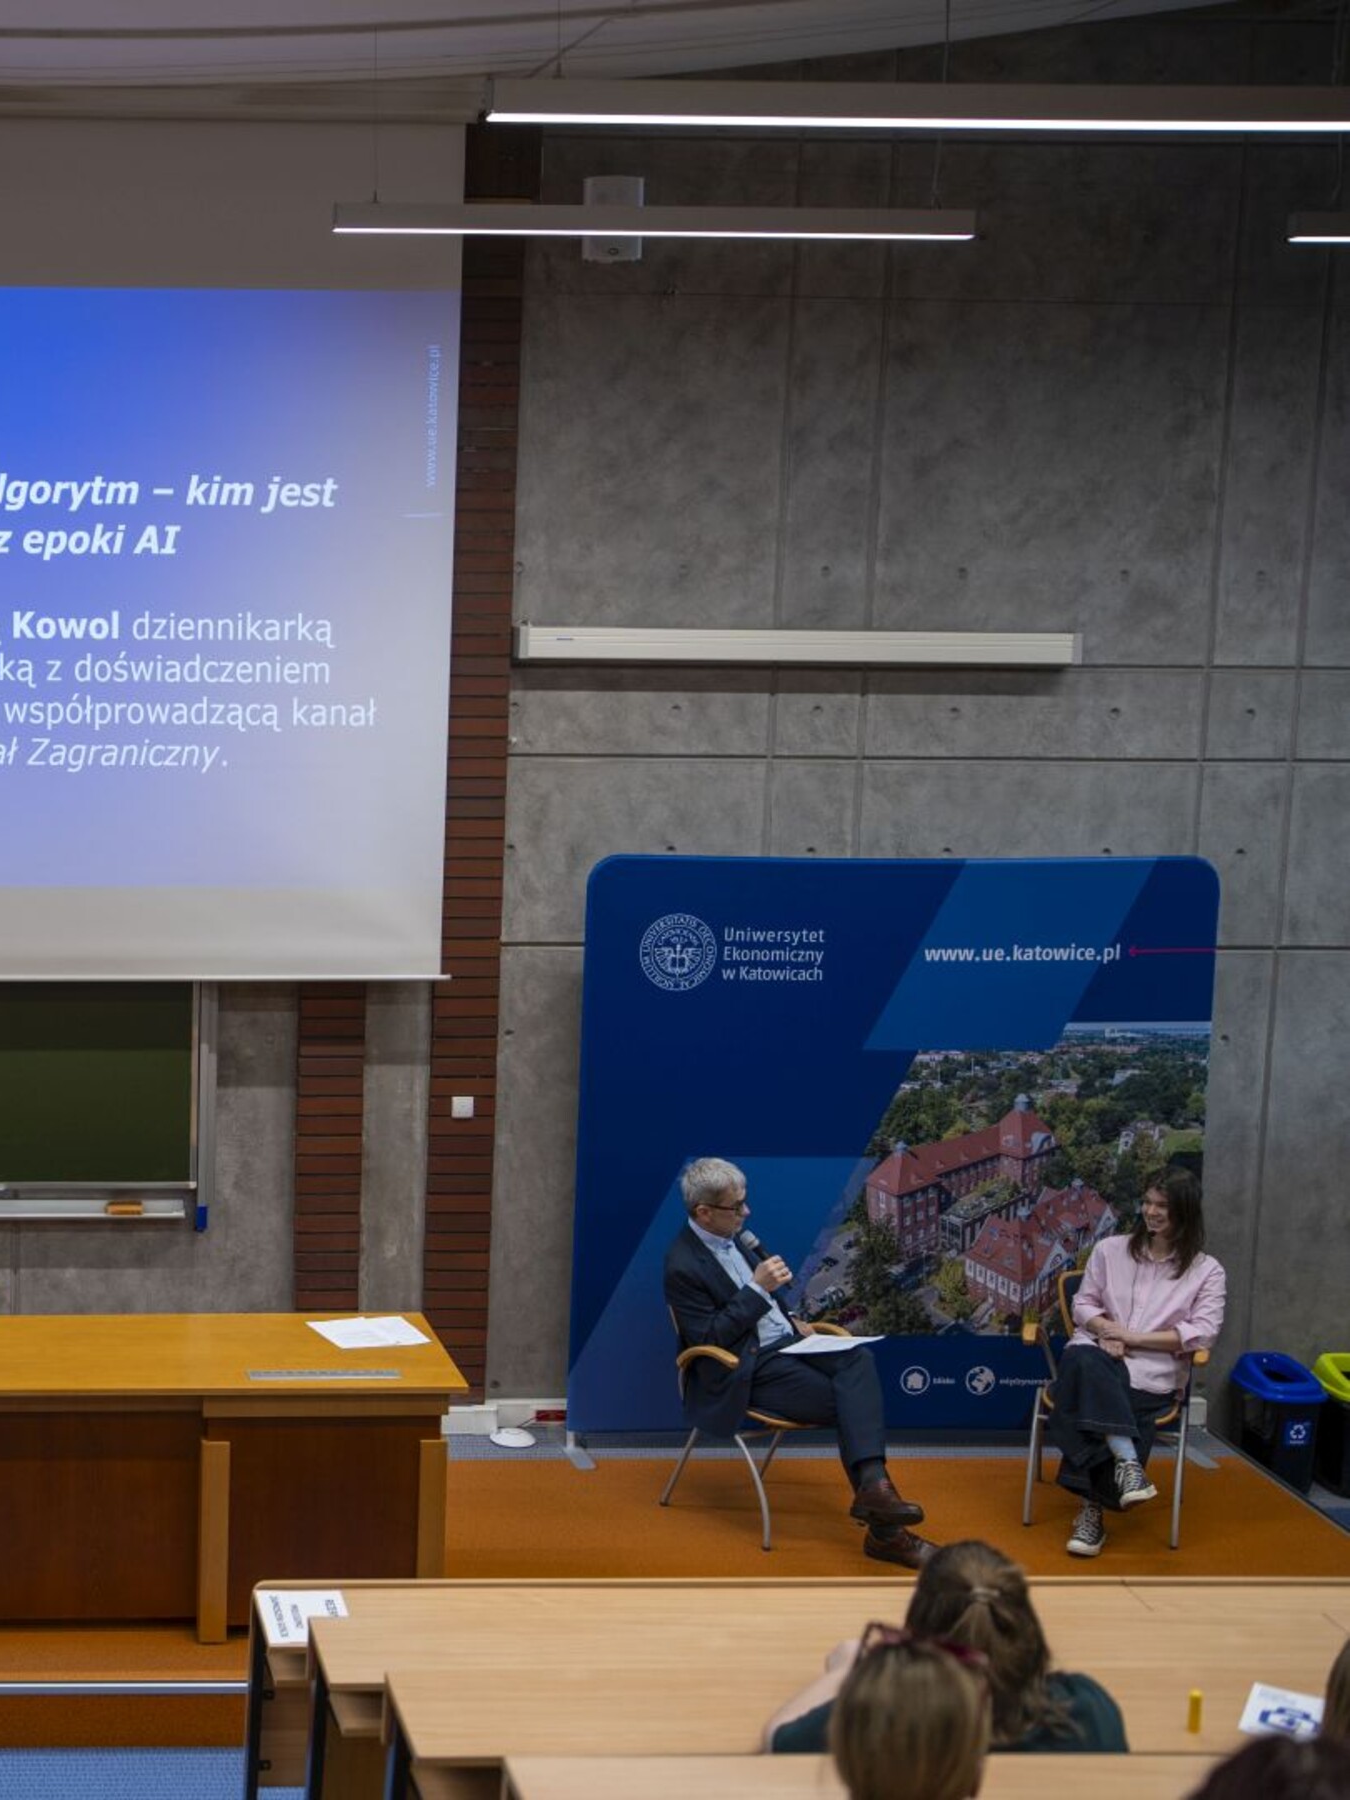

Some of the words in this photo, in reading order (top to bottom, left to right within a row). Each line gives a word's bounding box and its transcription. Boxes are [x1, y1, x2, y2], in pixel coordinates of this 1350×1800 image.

[426, 345, 441, 487] www.ue.katowice.pl
[186, 474, 254, 506] kim
[260, 476, 338, 513] jest
[23, 524, 126, 561] epoki
[133, 525, 181, 555] AI
[12, 611, 119, 640] Kowol
[132, 611, 335, 647] dziennikarką
[46, 659, 62, 681] z
[75, 652, 330, 684] doświadczeniem
[4, 693, 282, 732] współprowadzącą
[292, 697, 376, 726] kanał
[27, 738, 228, 773] Zagraniczny.
[724, 927, 825, 946] Uniwersytet
[924, 943, 1121, 964] www.ue.katowice.pl
[722, 969, 735, 980] w
[739, 966, 823, 981] Katowicach
[723, 946, 824, 966] Ekonomiczny
